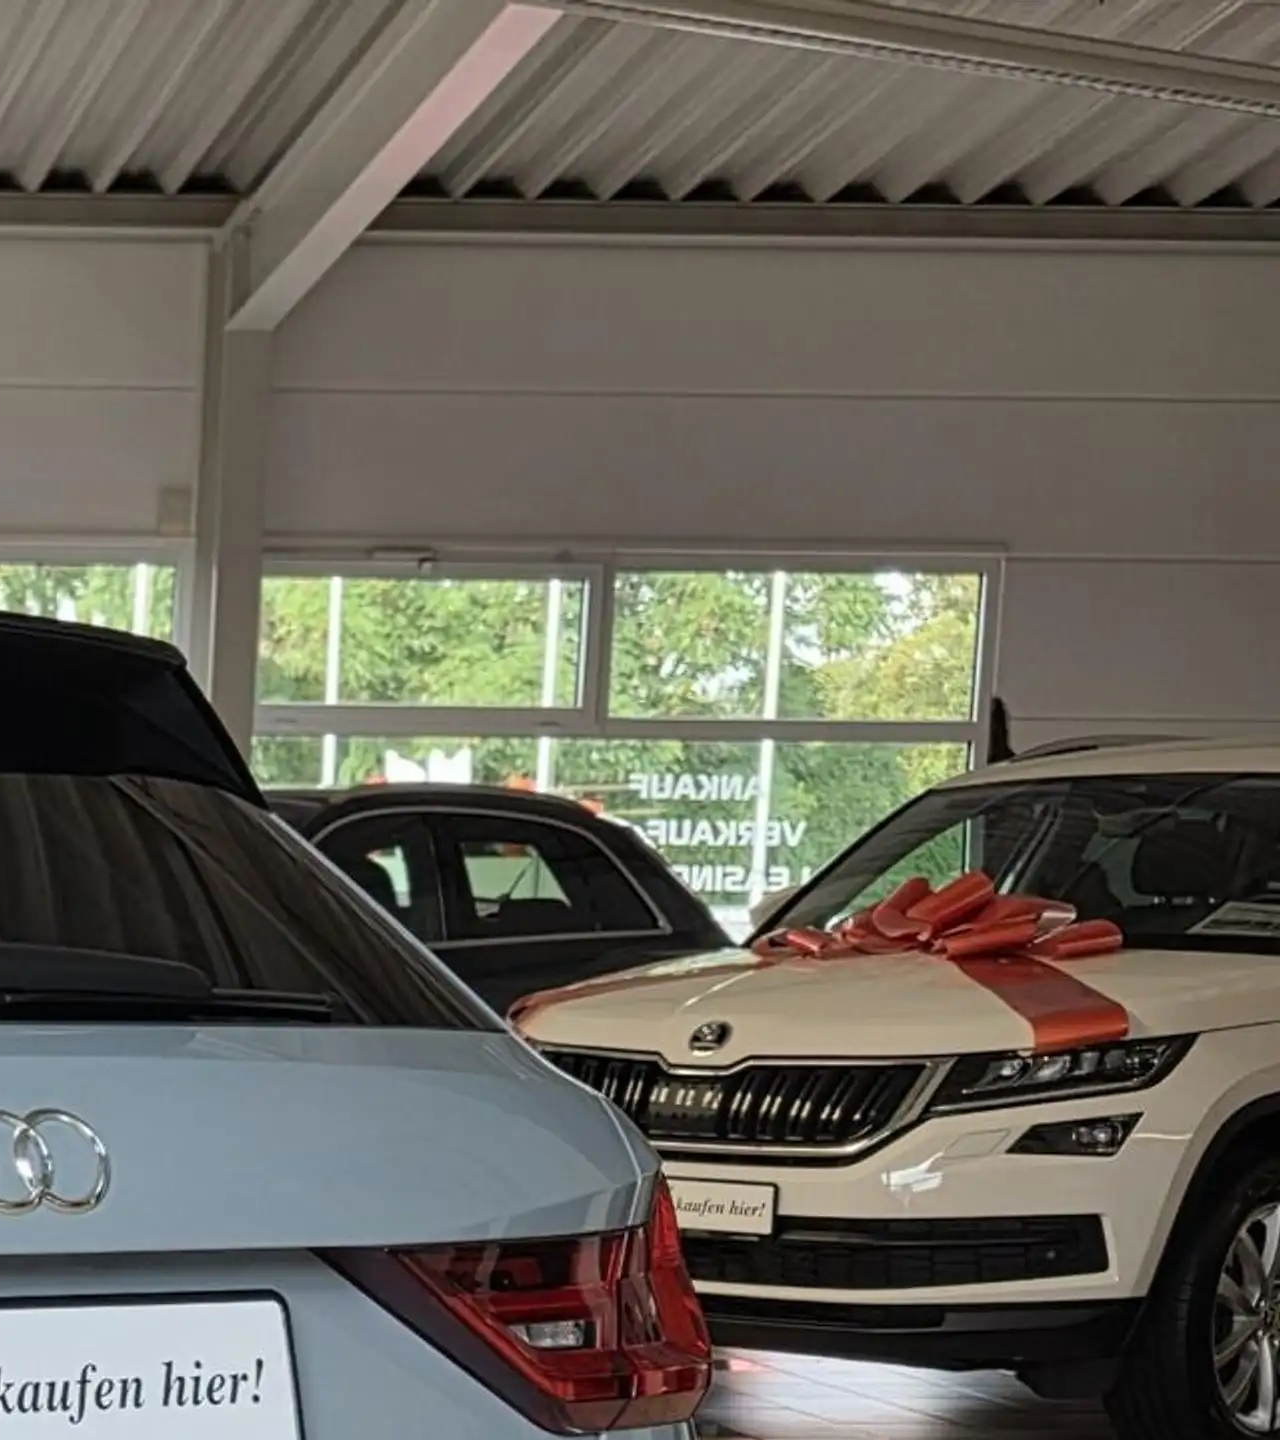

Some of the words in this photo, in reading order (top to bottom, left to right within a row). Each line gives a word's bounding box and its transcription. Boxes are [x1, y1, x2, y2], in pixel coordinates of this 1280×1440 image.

[676, 1196, 725, 1218] kaufen
[729, 1199, 767, 1218] hier!
[161, 1357, 265, 1408] hier!
